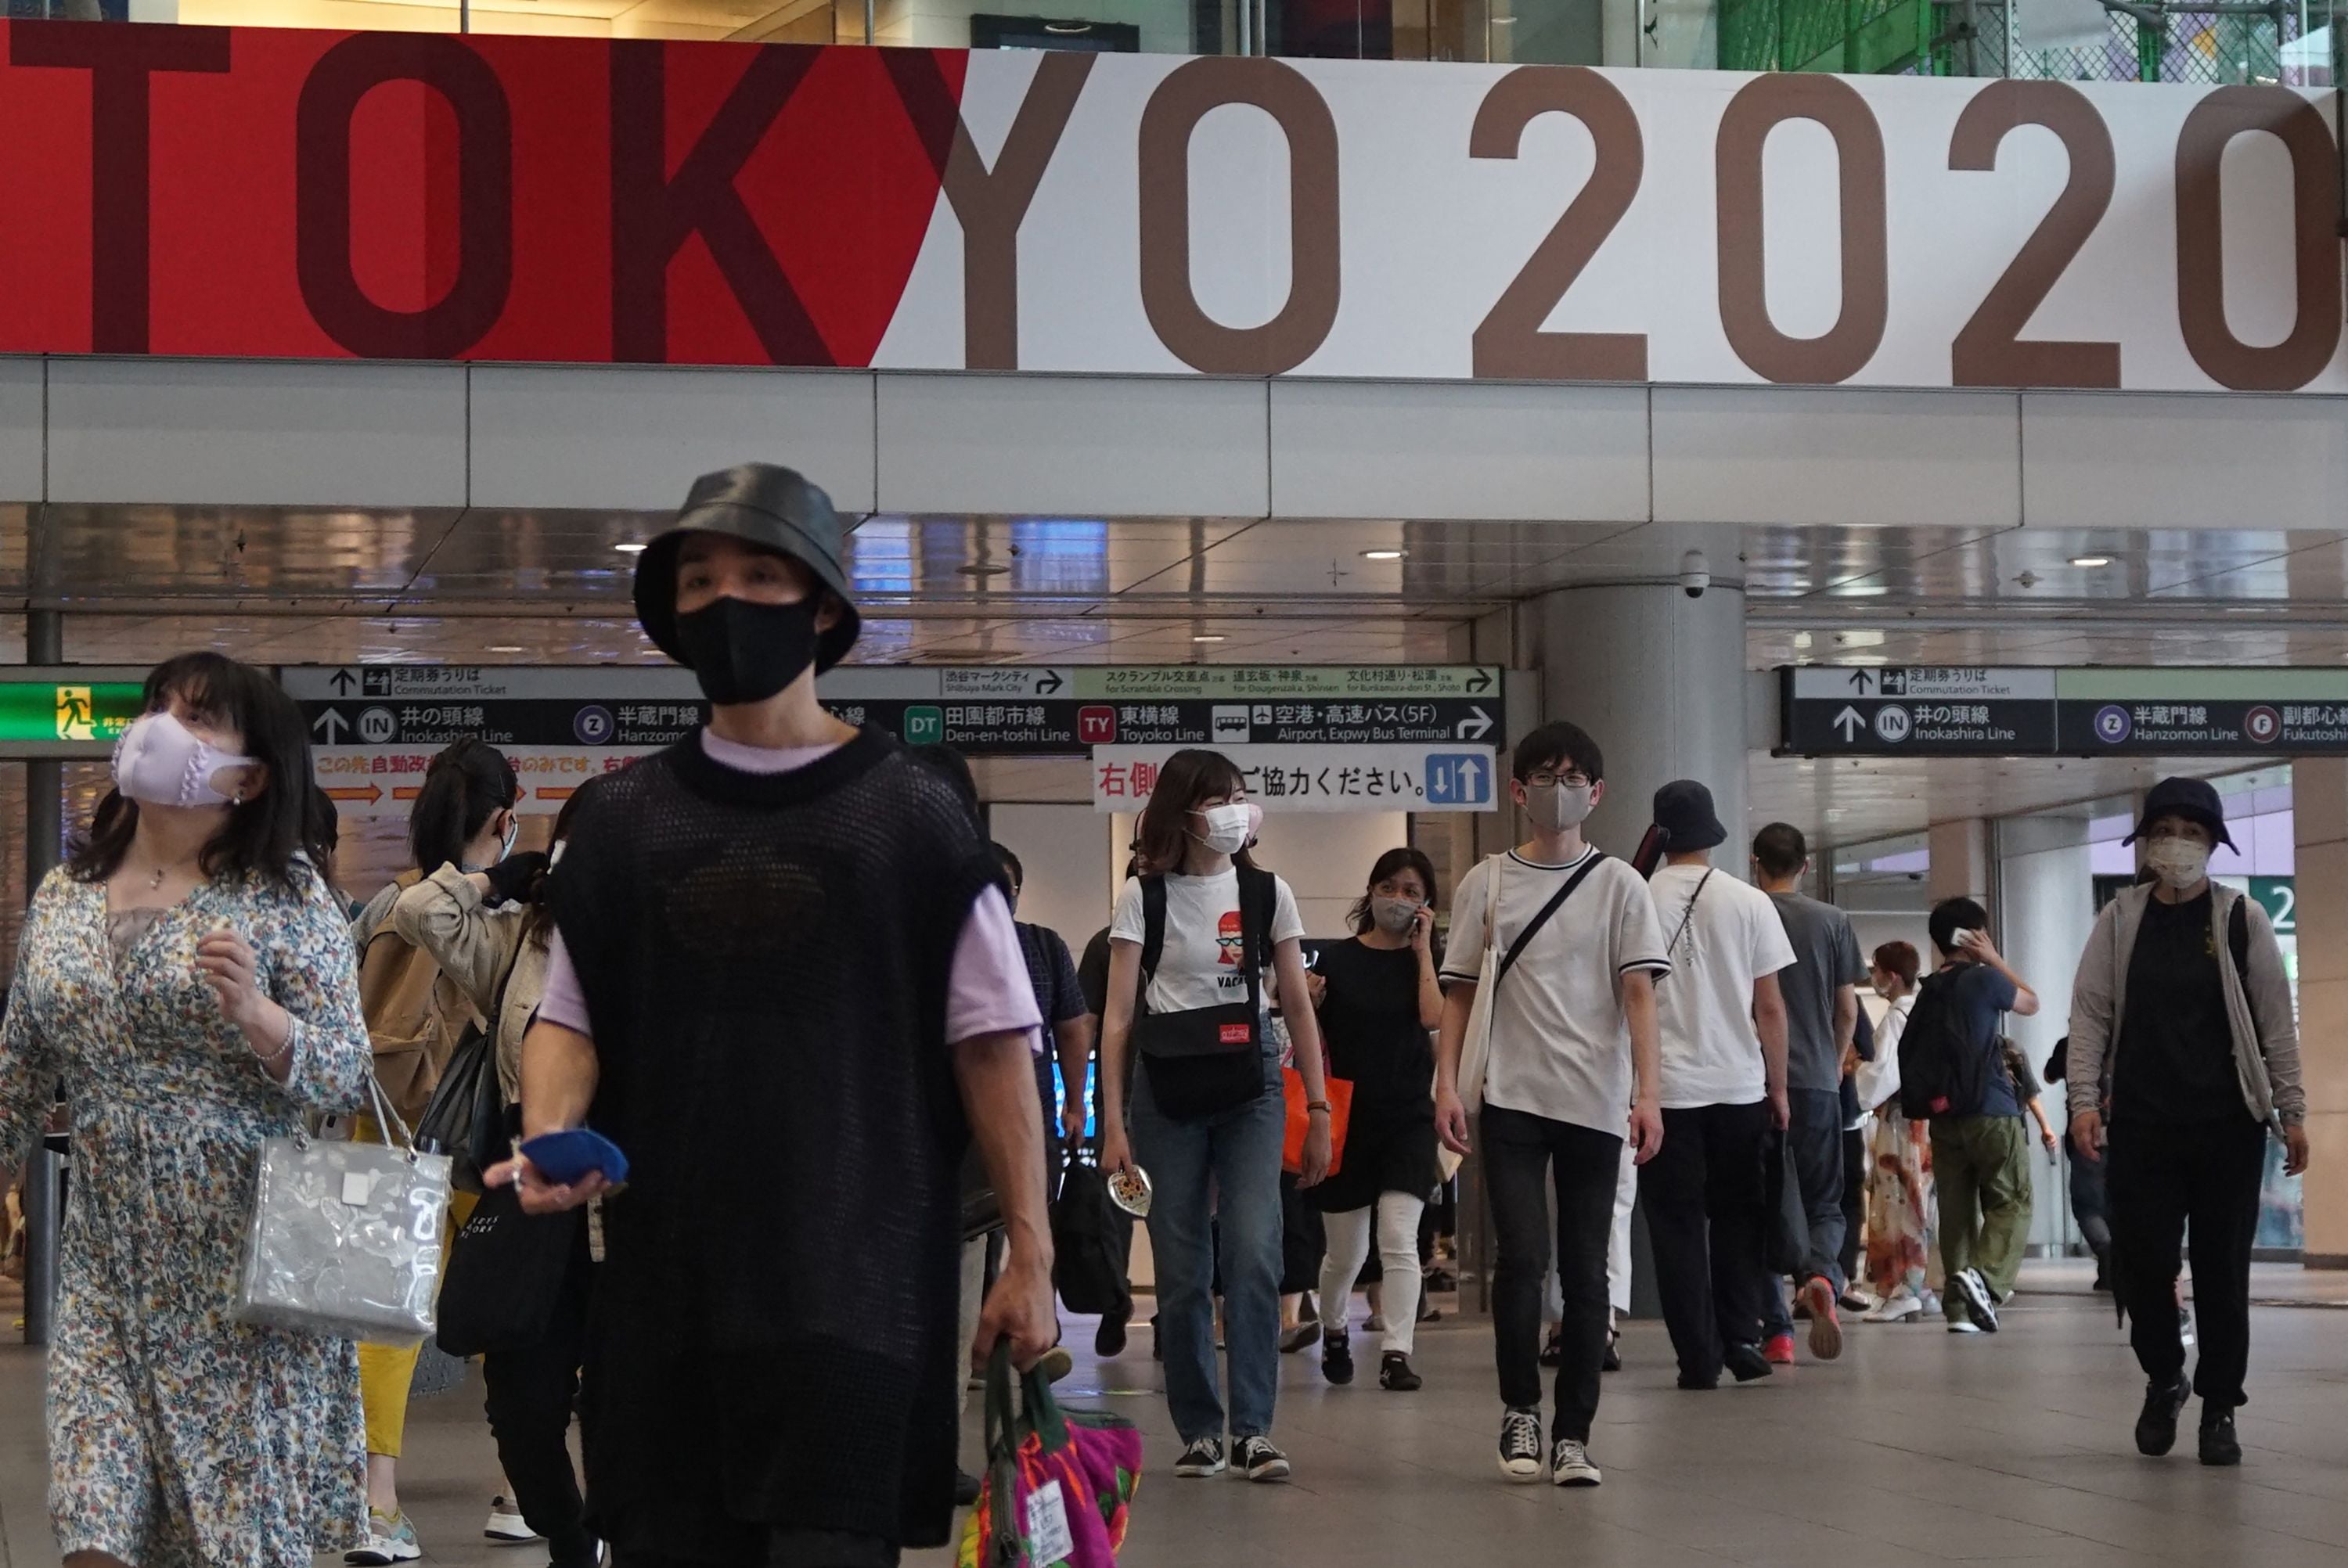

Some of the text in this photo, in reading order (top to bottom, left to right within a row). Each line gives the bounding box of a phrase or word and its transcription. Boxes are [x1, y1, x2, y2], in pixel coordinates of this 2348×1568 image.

[9, 19, 2342, 392] TOKYO 2020
[394, 667, 481, 682] 定期券うりば
[945, 671, 1029, 682] 渋谷マークシティ
[1910, 668, 1986, 682] 定期券うりば
[394, 684, 507, 696] Commutation Ticket
[1910, 685, 2011, 695] Commutation Ticket
[401, 706, 484, 727] 井の頭線
[618, 706, 699, 726] 半蔵門線
[945, 707, 1046, 725] 田園都市線
[1119, 705, 1179, 725] 東横線
[1914, 705, 1990, 725] 井の頭線
[2134, 706, 2208, 725] 半蔵門線
[365, 717, 389, 734] IN
[911, 717, 937, 733] DT
[1085, 717, 1110, 732] TY
[1883, 715, 1903, 731] IN
[482, 730, 513, 743] Line
[946, 728, 1071, 743] Den-en-toshi Line
[1120, 728, 1205, 743] Toyoko Line
[1277, 726, 1450, 743] Airport, Expwy Bus Terminal
[1915, 727, 2016, 740] Inokashira Line
[2134, 728, 2238, 741] Hanzomon Line
[2283, 728, 2348, 741] Fukutoshi
